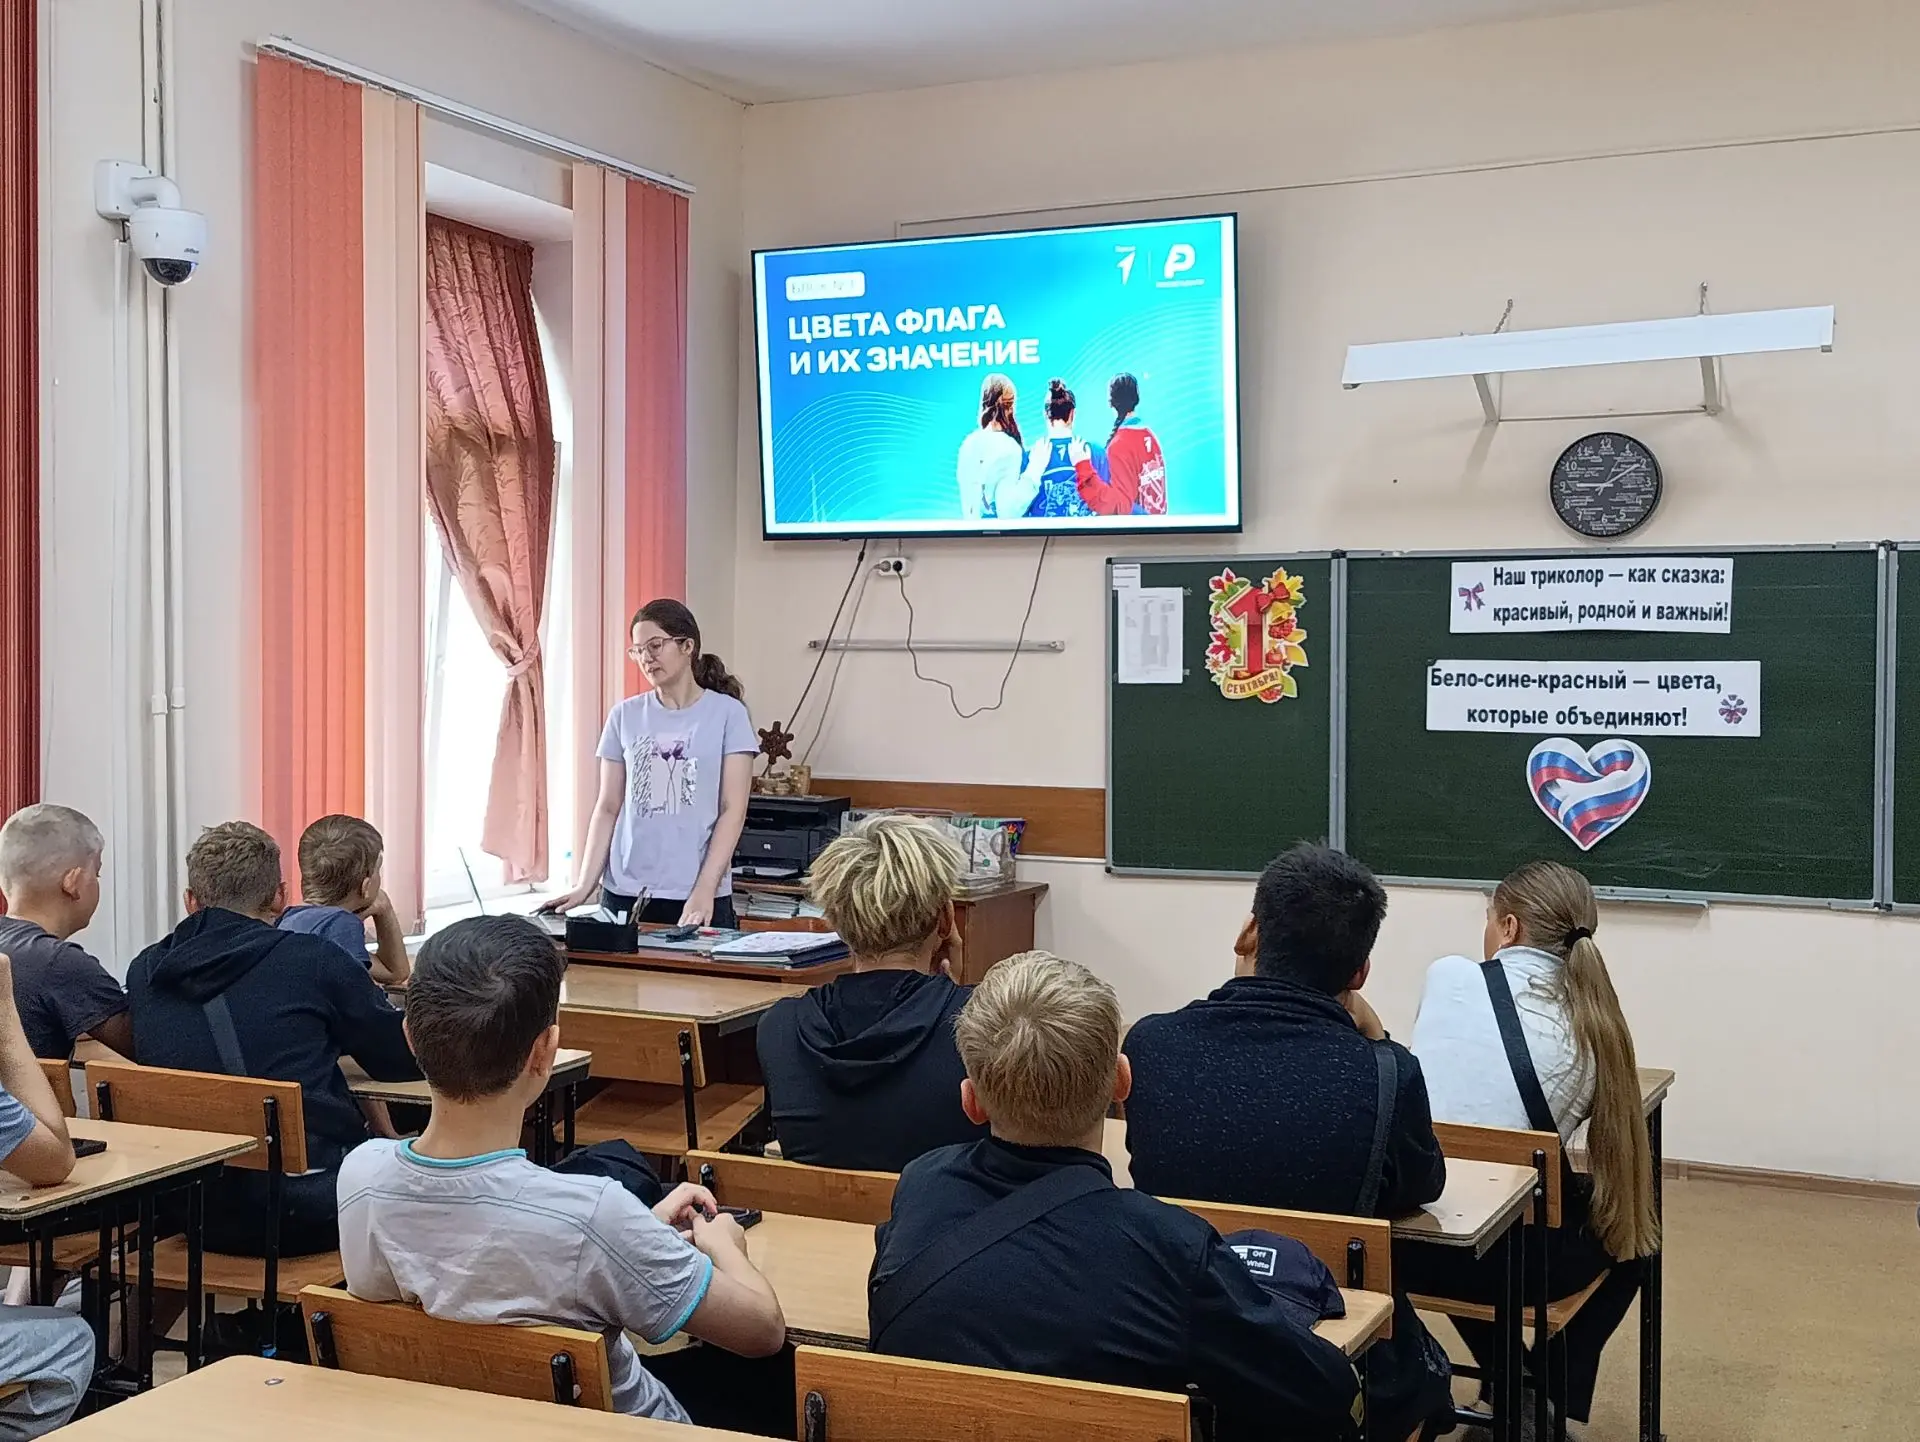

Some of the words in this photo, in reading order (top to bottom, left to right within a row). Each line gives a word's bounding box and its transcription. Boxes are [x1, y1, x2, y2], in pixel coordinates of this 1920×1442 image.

[788, 311, 891, 343] ЦВЕТА
[895, 303, 1006, 335] ФЛАГА
[790, 351, 811, 375] И
[817, 348, 862, 374] ИХ
[866, 338, 1040, 372] ЗНАЧЕНИЕ
[1600, 438, 1611, 449] 12
[1565, 461, 1577, 471] 10
[1560, 481, 1566, 492] 9
[1564, 499, 1570, 510] 8
[1493, 566, 1526, 586] Наш
[1530, 569, 1604, 589] триколор
[1628, 568, 1657, 582] как
[1661, 568, 1725, 584] сказка:
[1493, 600, 1573, 626] красивый,
[1578, 599, 1636, 624] родной
[1642, 604, 1651, 620] и
[1656, 601, 1729, 622] важный!
[1226, 670, 1279, 694] СЕНТЯБРЯ!
[1430, 668, 1627, 694] Бело-сине-красный
[1657, 674, 1722, 694] цвета,
[1467, 708, 1549, 728] которые
[1556, 705, 1687, 730] объединяют!
